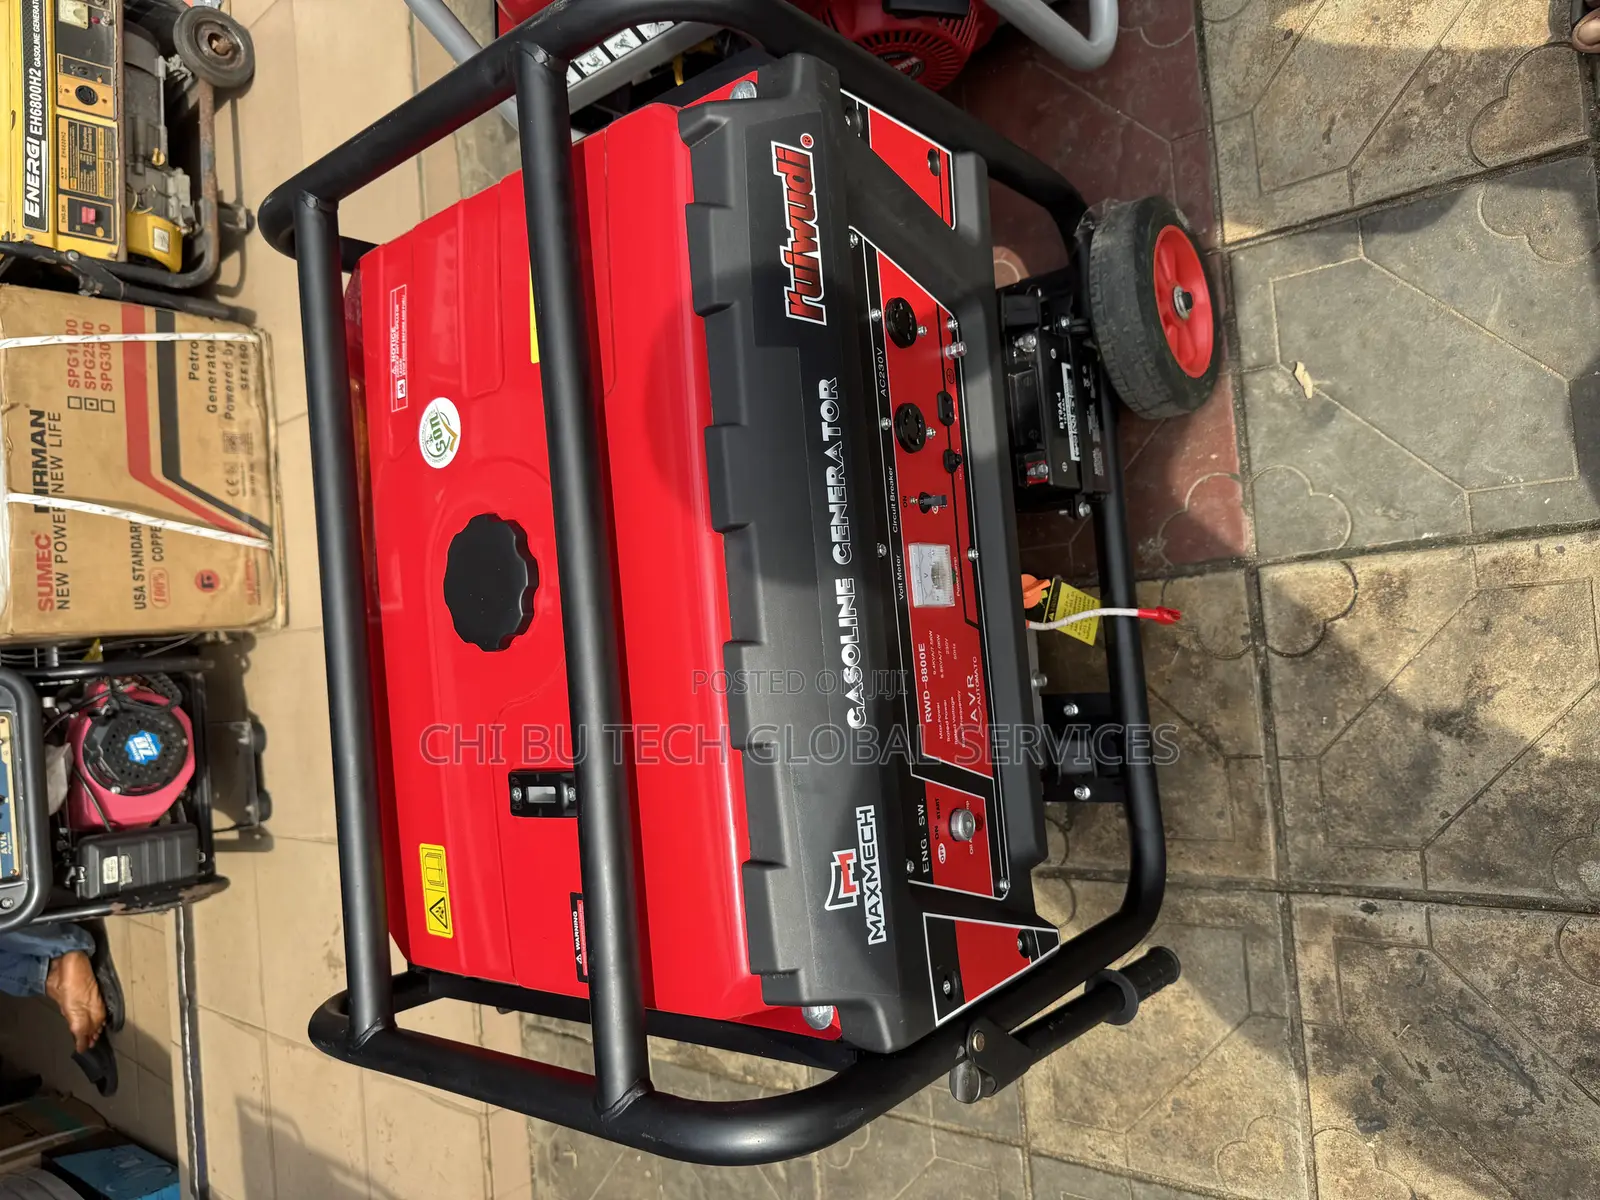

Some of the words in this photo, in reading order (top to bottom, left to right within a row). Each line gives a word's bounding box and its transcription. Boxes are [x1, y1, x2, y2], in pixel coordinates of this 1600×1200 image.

[33, 33, 41, 67] GASOLINE
[29, 68, 43, 135] EH6800H2
[24, 136, 40, 218] ENERGI
[771, 141, 827, 325] ruiwudi
[66, 319, 80, 388] SPG100
[98, 324, 113, 392] SPG300
[222, 340, 235, 356] by
[876, 347, 887, 397] AC230V
[222, 361, 235, 420] Powered
[48, 412, 62, 447] LIFE
[49, 455, 64, 493] NEW
[818, 377, 852, 565] GENERATOR
[903, 495, 908, 508] ON
[150, 526, 164, 562] COPPE
[35, 534, 54, 612] SUMEC
[56, 572, 70, 610] NEW
[133, 585, 147, 610] USA
[835, 577, 866, 729] GASOLINE
[918, 642, 932, 723] RWD-8800E
[966, 674, 978, 722] AVR
[920, 833, 929, 873] ENG.
[934, 825, 939, 840] ON
[856, 806, 886, 944] MAXMECH
[572, 910, 580, 950] WARNING
